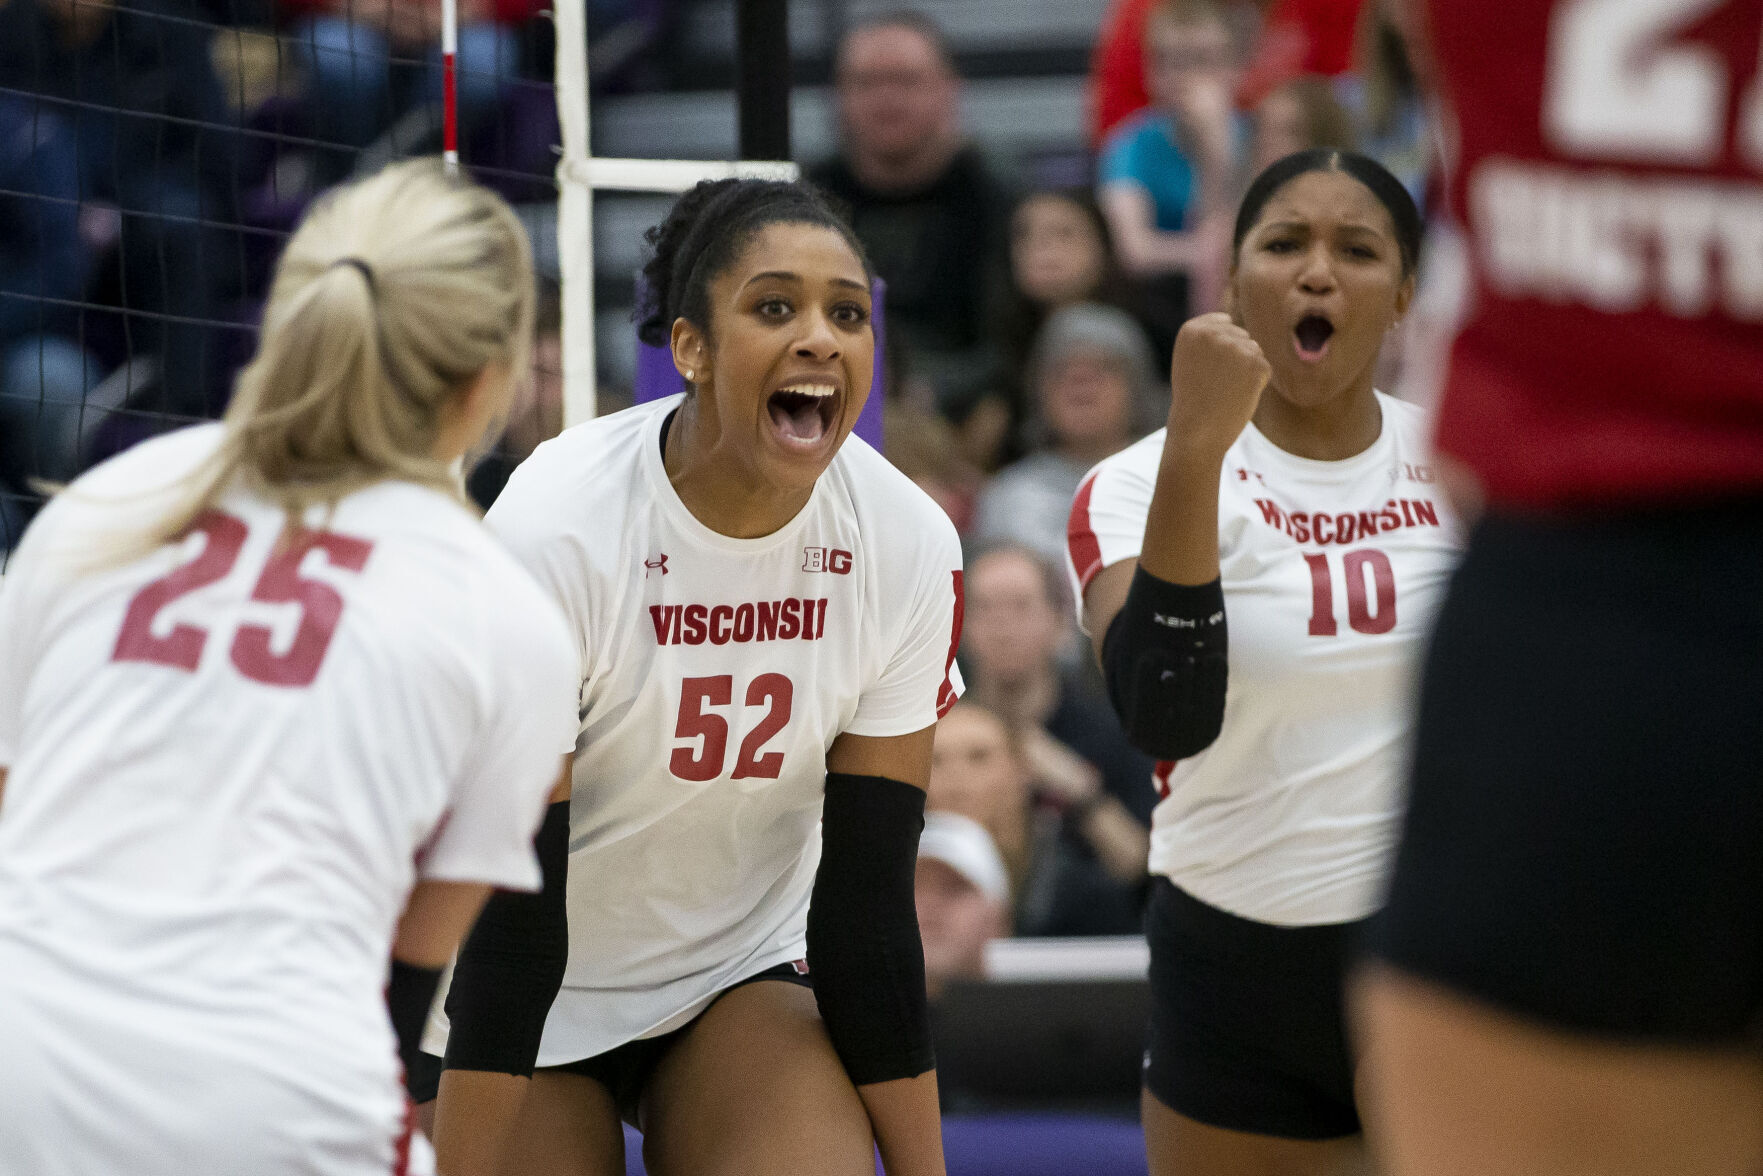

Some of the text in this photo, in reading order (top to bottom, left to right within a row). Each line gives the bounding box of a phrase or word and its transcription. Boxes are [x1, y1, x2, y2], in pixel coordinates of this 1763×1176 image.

[1542, 0, 1763, 163] 2
[1253, 498, 1440, 545] WISCONSIN
[110, 508, 376, 687] 25
[1303, 549, 1397, 636] 10
[669, 672, 794, 782] 52
